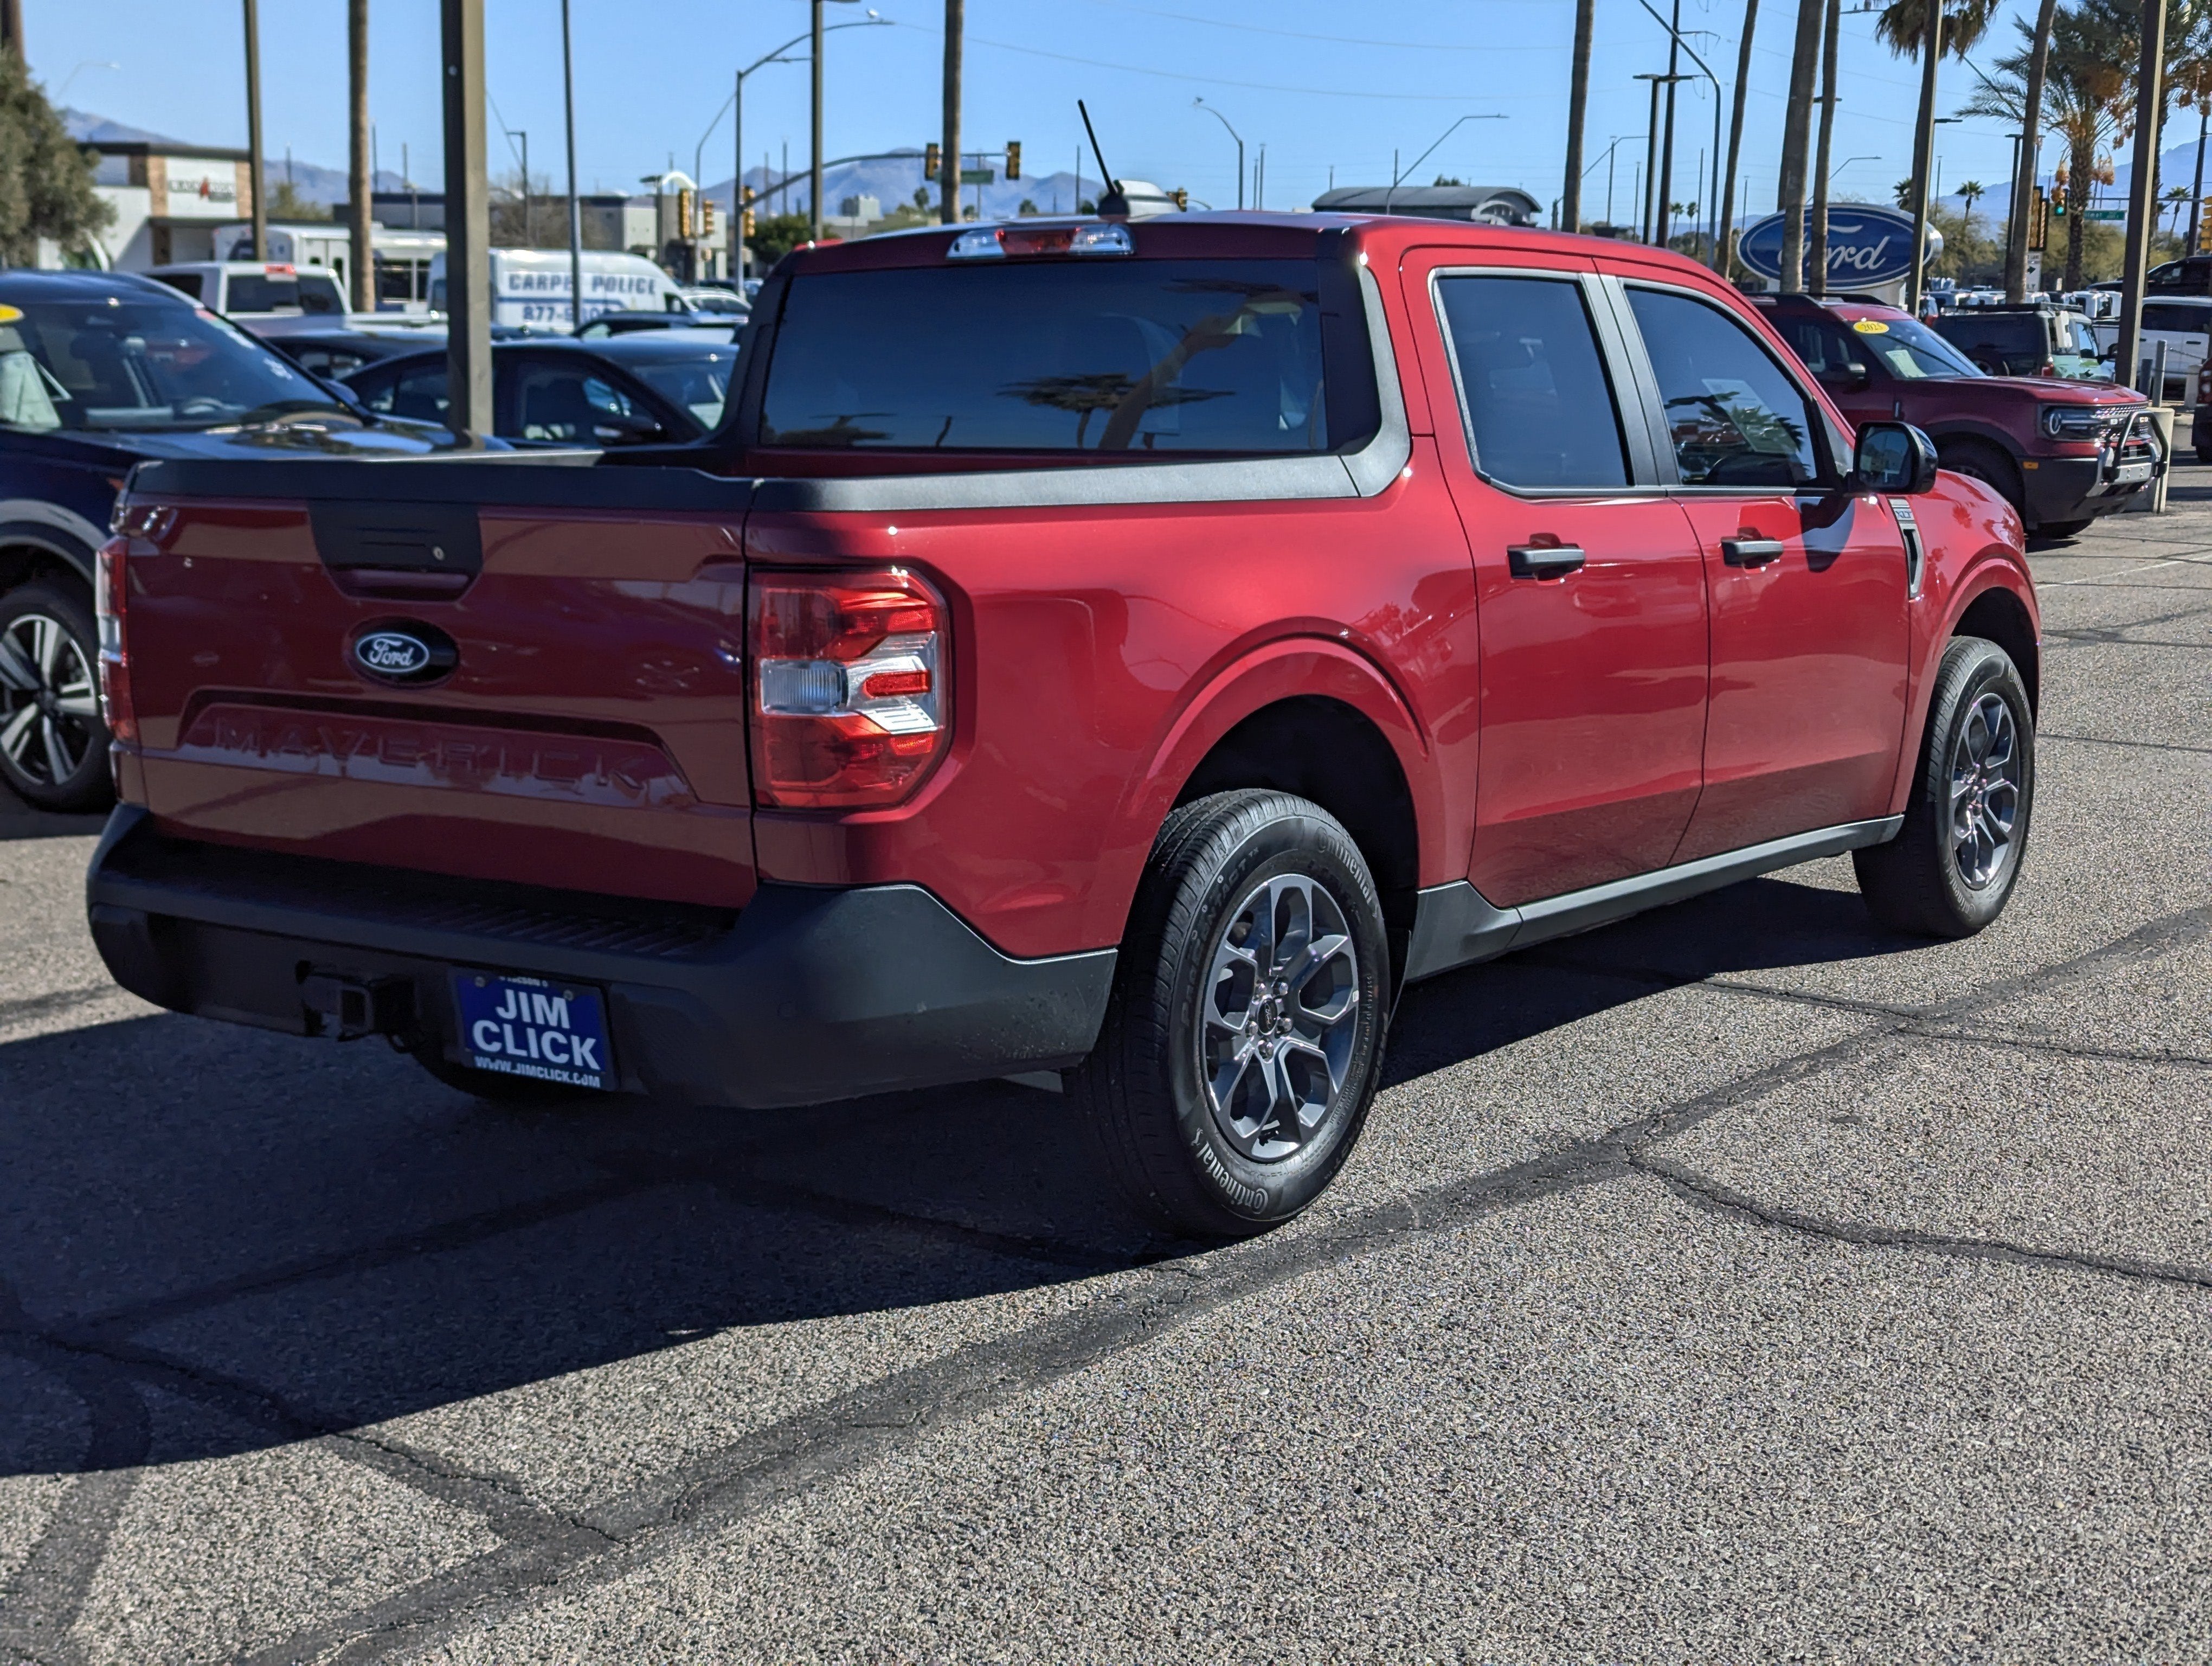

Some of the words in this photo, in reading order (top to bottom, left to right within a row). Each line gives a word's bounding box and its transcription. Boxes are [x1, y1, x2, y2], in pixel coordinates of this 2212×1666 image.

[509, 274, 573, 291] CARPE
[593, 276, 655, 294] POLICE
[1895, 510, 1912, 518] XLT
[369, 638, 415, 667] Ford
[216, 716, 647, 790] MAVERICK
[1314, 826, 1373, 905] Continental
[495, 989, 570, 1029] JIM
[472, 1020, 601, 1071] CLICK
[473, 1055, 602, 1089] WWW.JIMCLICK.COM
[1195, 1141, 1269, 1214] Continental
